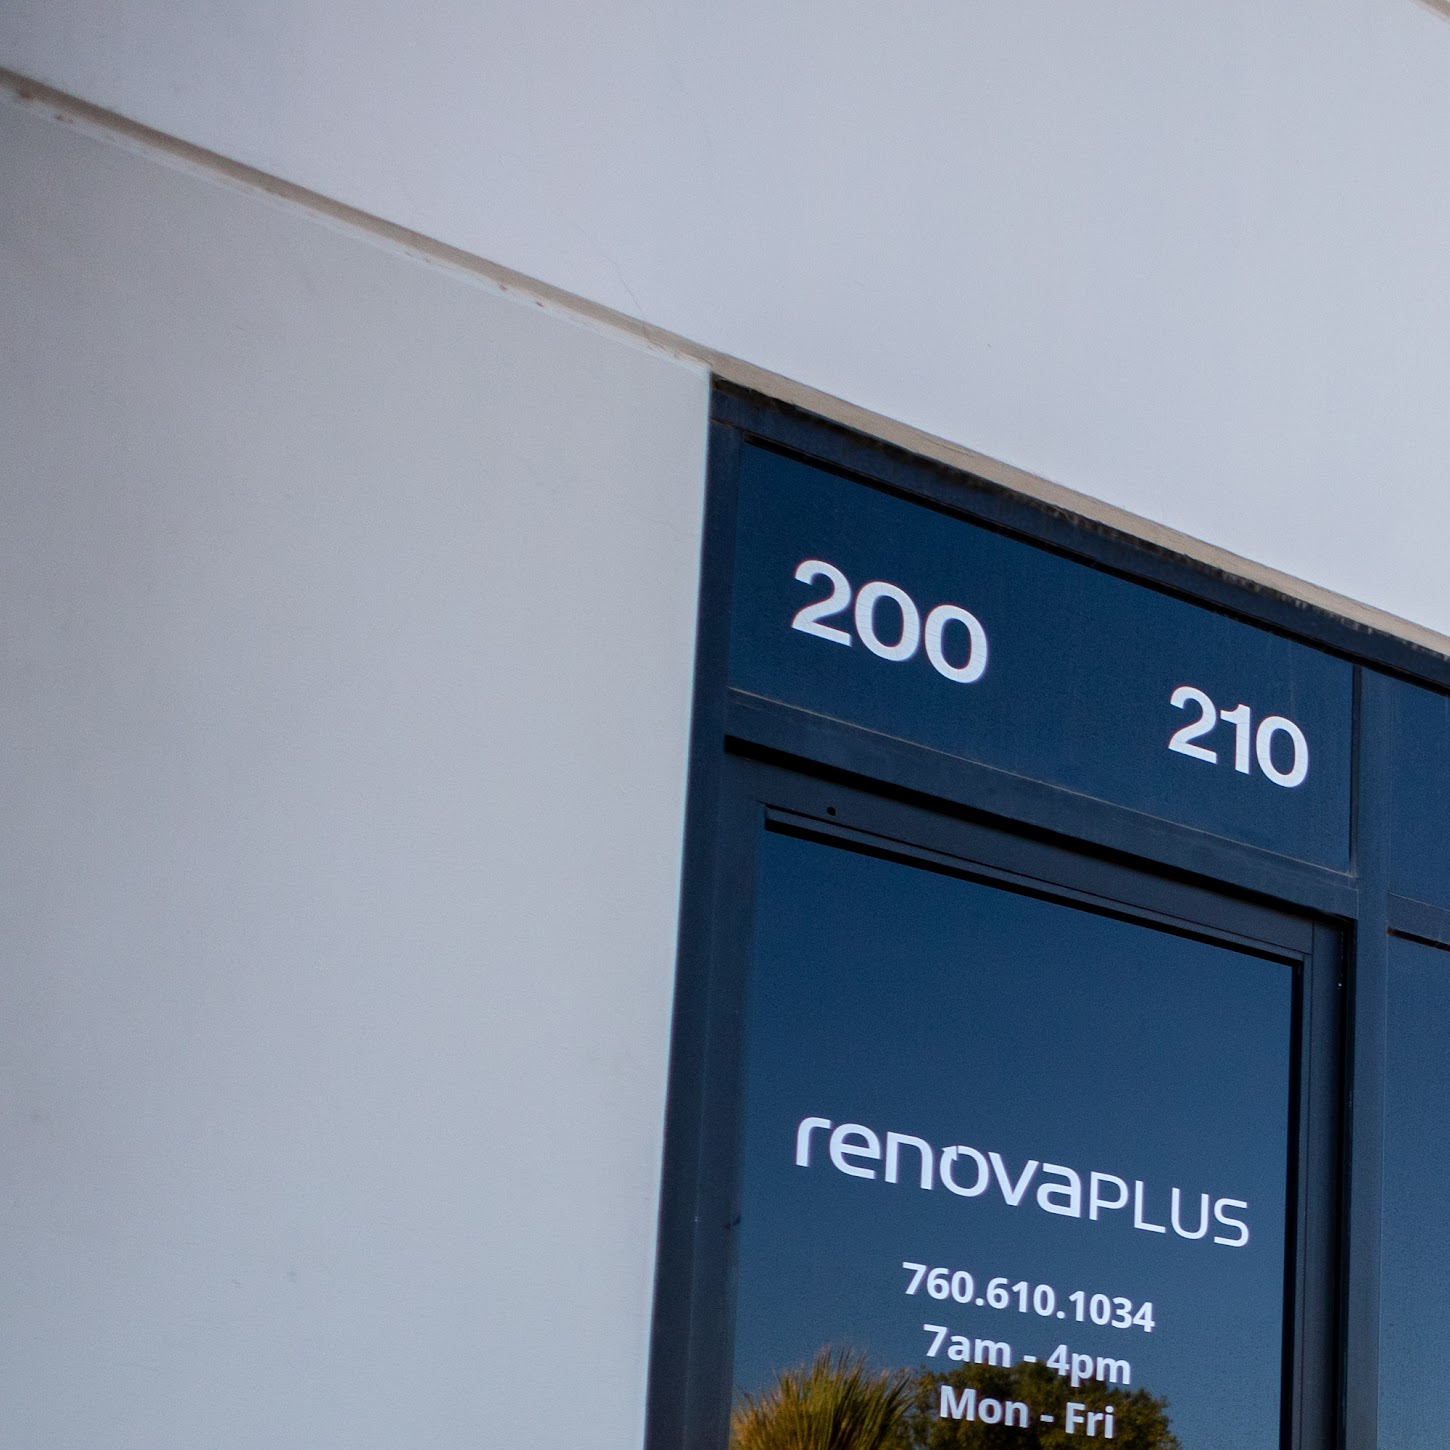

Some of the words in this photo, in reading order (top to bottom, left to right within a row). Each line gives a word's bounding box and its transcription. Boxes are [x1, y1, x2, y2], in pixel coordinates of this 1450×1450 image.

[791, 559, 988, 683] 200
[1168, 685, 1309, 788] 210
[795, 1116, 1250, 1248] renovaPLUS
[902, 1261, 1156, 1334] 760.610.1034
[923, 1323, 1012, 1369] 7am
[1045, 1344, 1132, 1389] 4pm
[940, 1385, 1030, 1429] Mon
[1065, 1401, 1115, 1439] Fri
